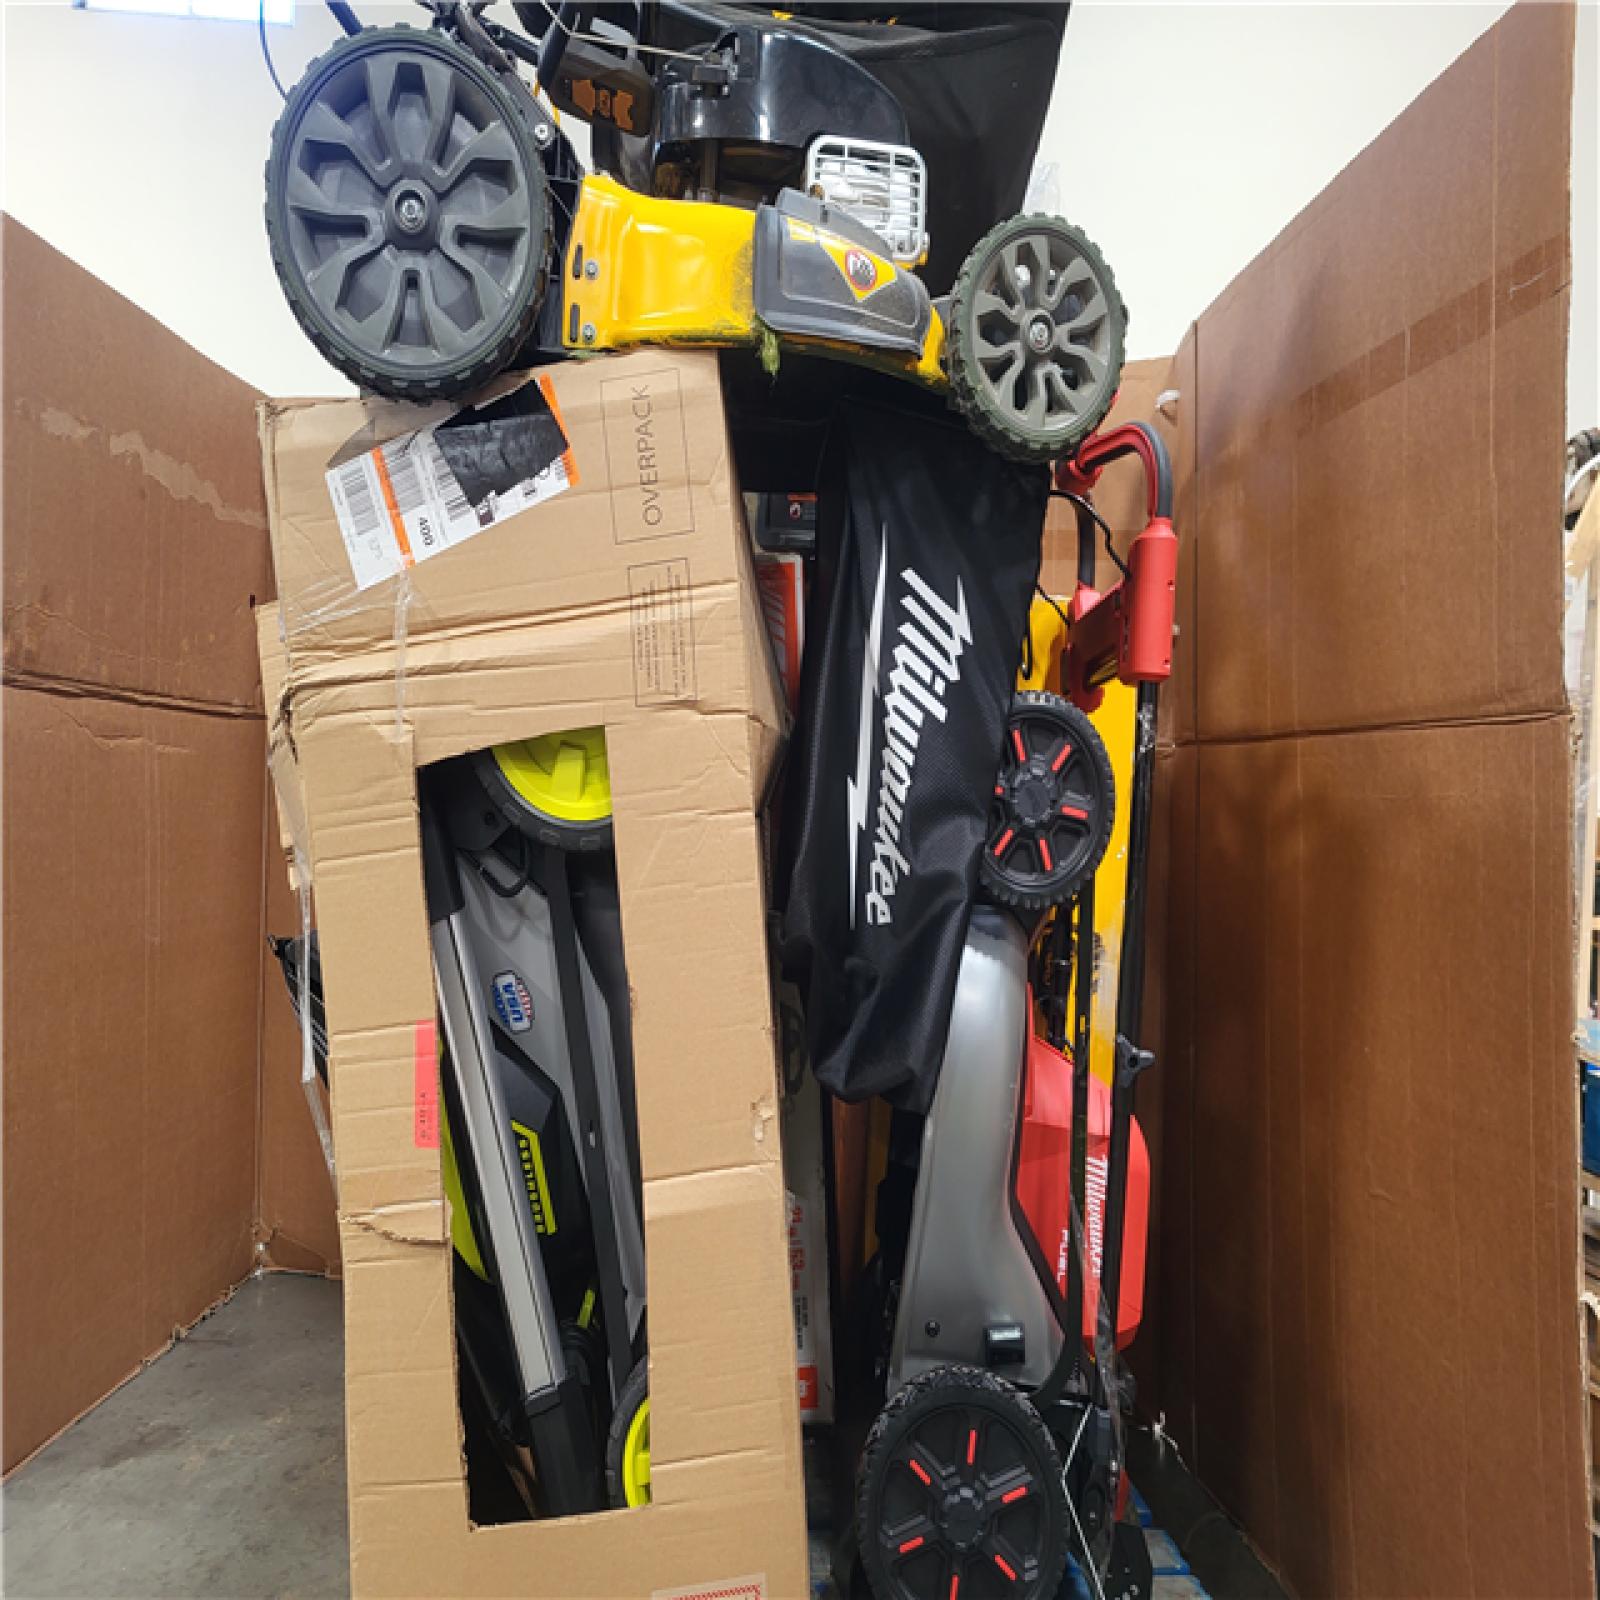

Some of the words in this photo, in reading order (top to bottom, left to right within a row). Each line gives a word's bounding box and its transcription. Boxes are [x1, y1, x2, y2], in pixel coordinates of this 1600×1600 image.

[631, 384, 663, 526] OVERPACK
[865, 567, 973, 926] Milwaukee
[1056, 1229, 1070, 1283] FUEL
